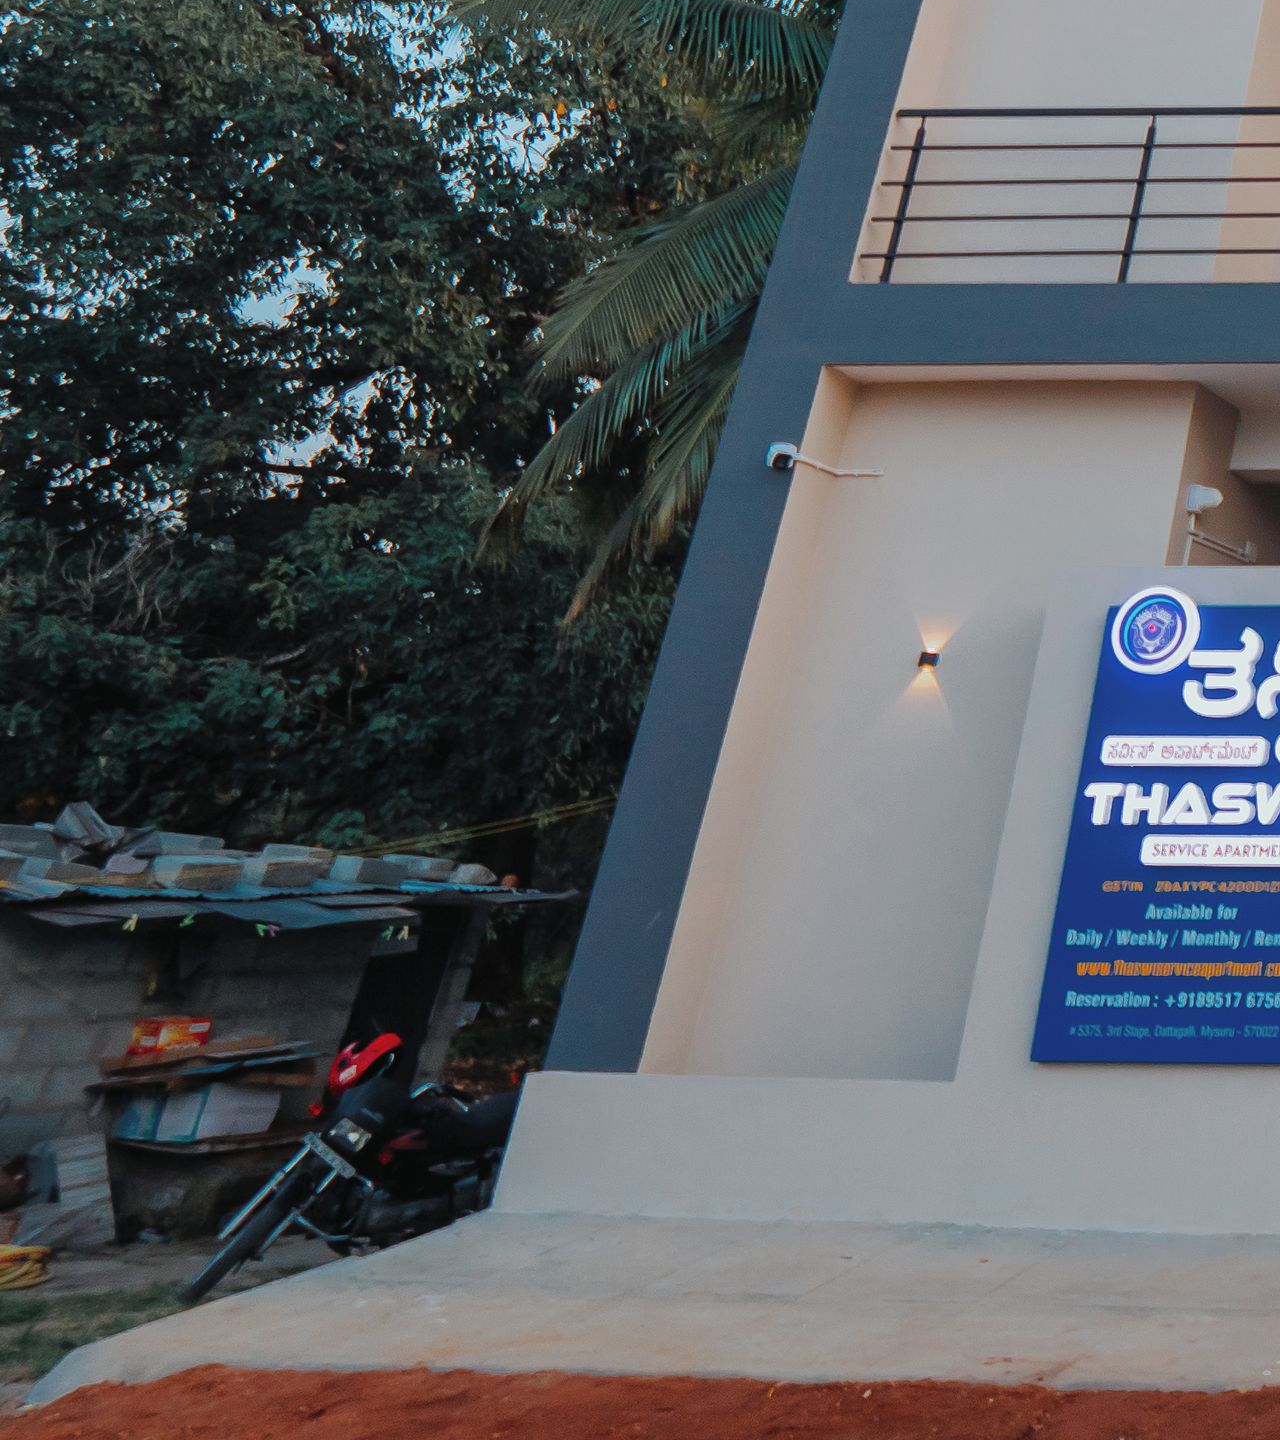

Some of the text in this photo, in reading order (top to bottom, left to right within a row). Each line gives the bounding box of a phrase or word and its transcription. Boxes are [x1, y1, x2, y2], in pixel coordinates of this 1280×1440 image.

[1151, 843, 1209, 858] SERVICE
[1145, 903, 1239, 920] Available for
[1066, 929, 1103, 949] Daily
[1116, 929, 1169, 949] Weekly
[1181, 929, 1242, 950] Monthly
[1065, 990, 1151, 1008] Reservation
